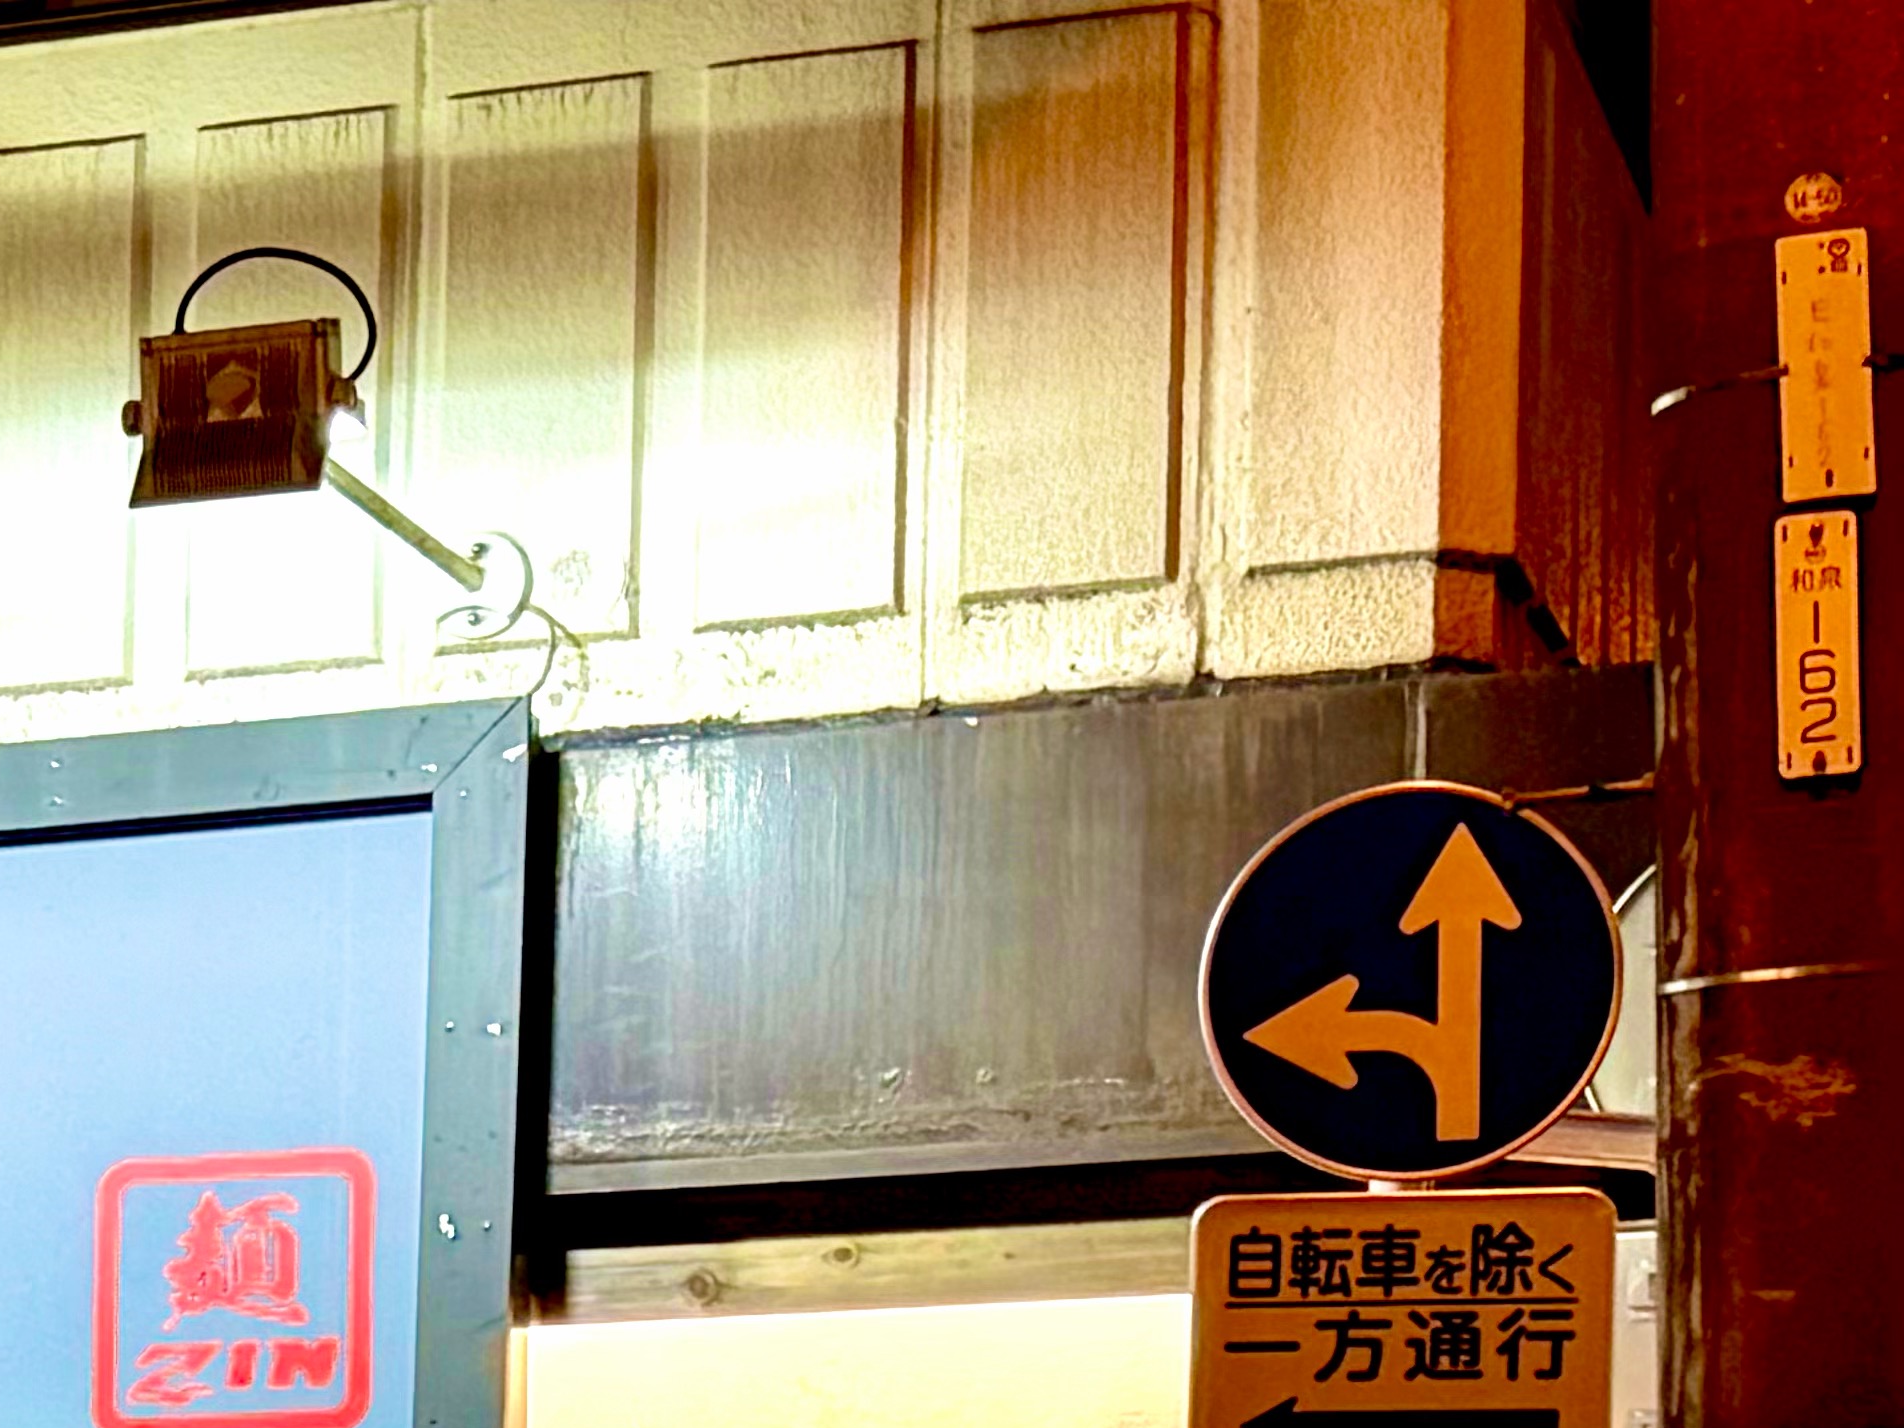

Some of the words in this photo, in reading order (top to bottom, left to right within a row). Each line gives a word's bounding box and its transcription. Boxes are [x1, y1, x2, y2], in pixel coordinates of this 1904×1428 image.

[1800, 600, 1837, 744] 162
[162, 1190, 309, 1332] 麺
[1228, 1221, 1574, 1298] 自転車を除く
[125, 1337, 340, 1407] ZIN
[1223, 1308, 1576, 1382] 一方通行
